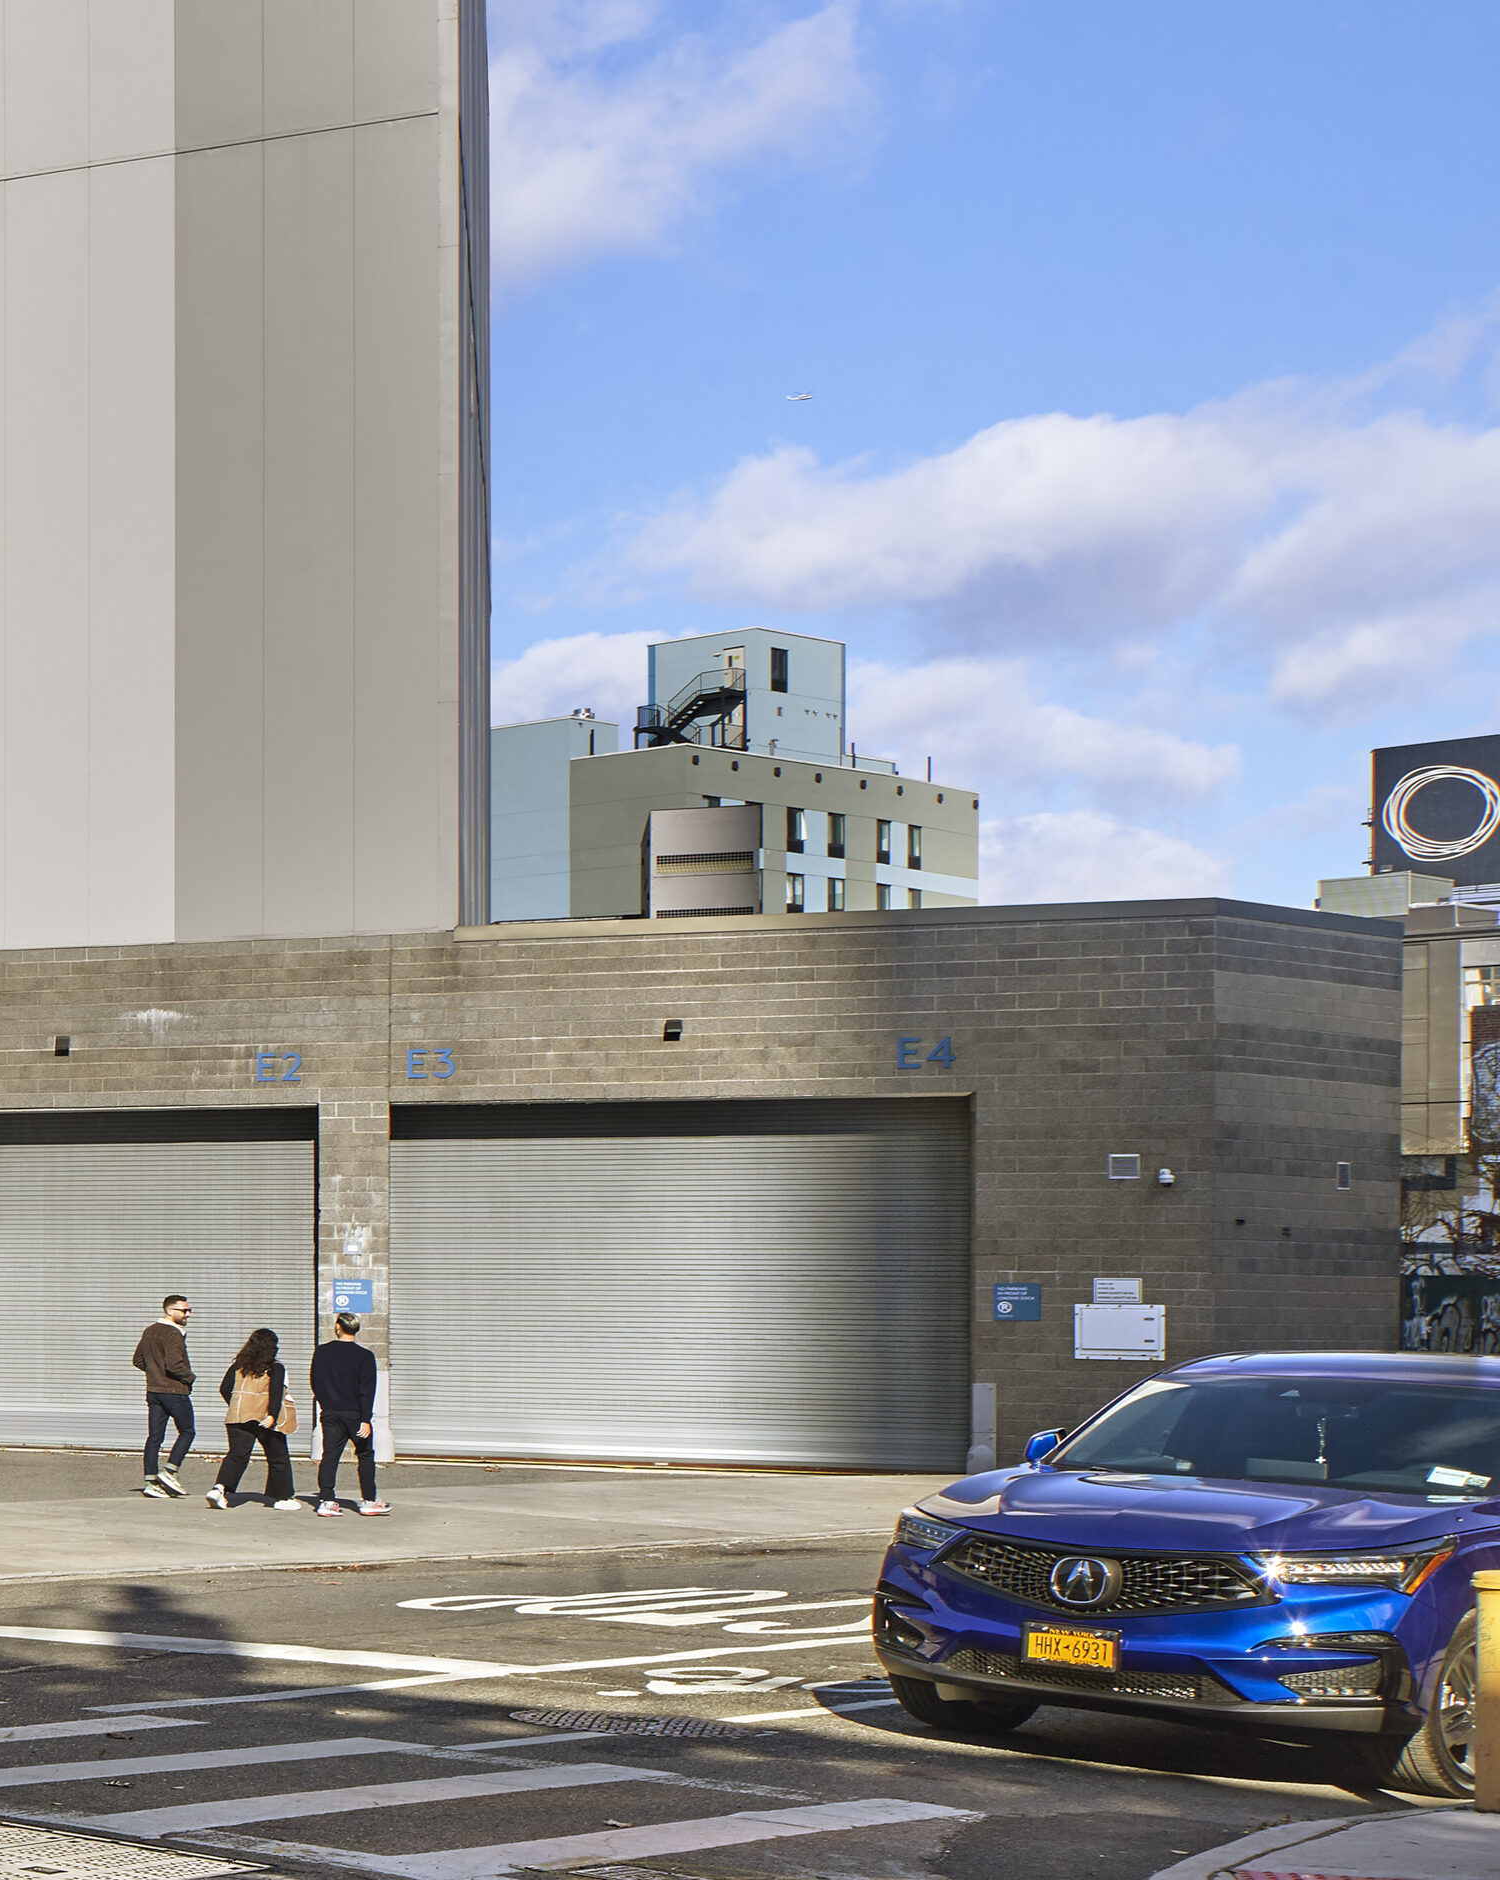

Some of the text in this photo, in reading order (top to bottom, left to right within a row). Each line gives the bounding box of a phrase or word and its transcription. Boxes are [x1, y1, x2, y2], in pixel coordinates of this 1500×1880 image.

[257, 1052, 302, 1082] E2
[407, 1048, 455, 1079] E3
[897, 1036, 956, 1070] E4
